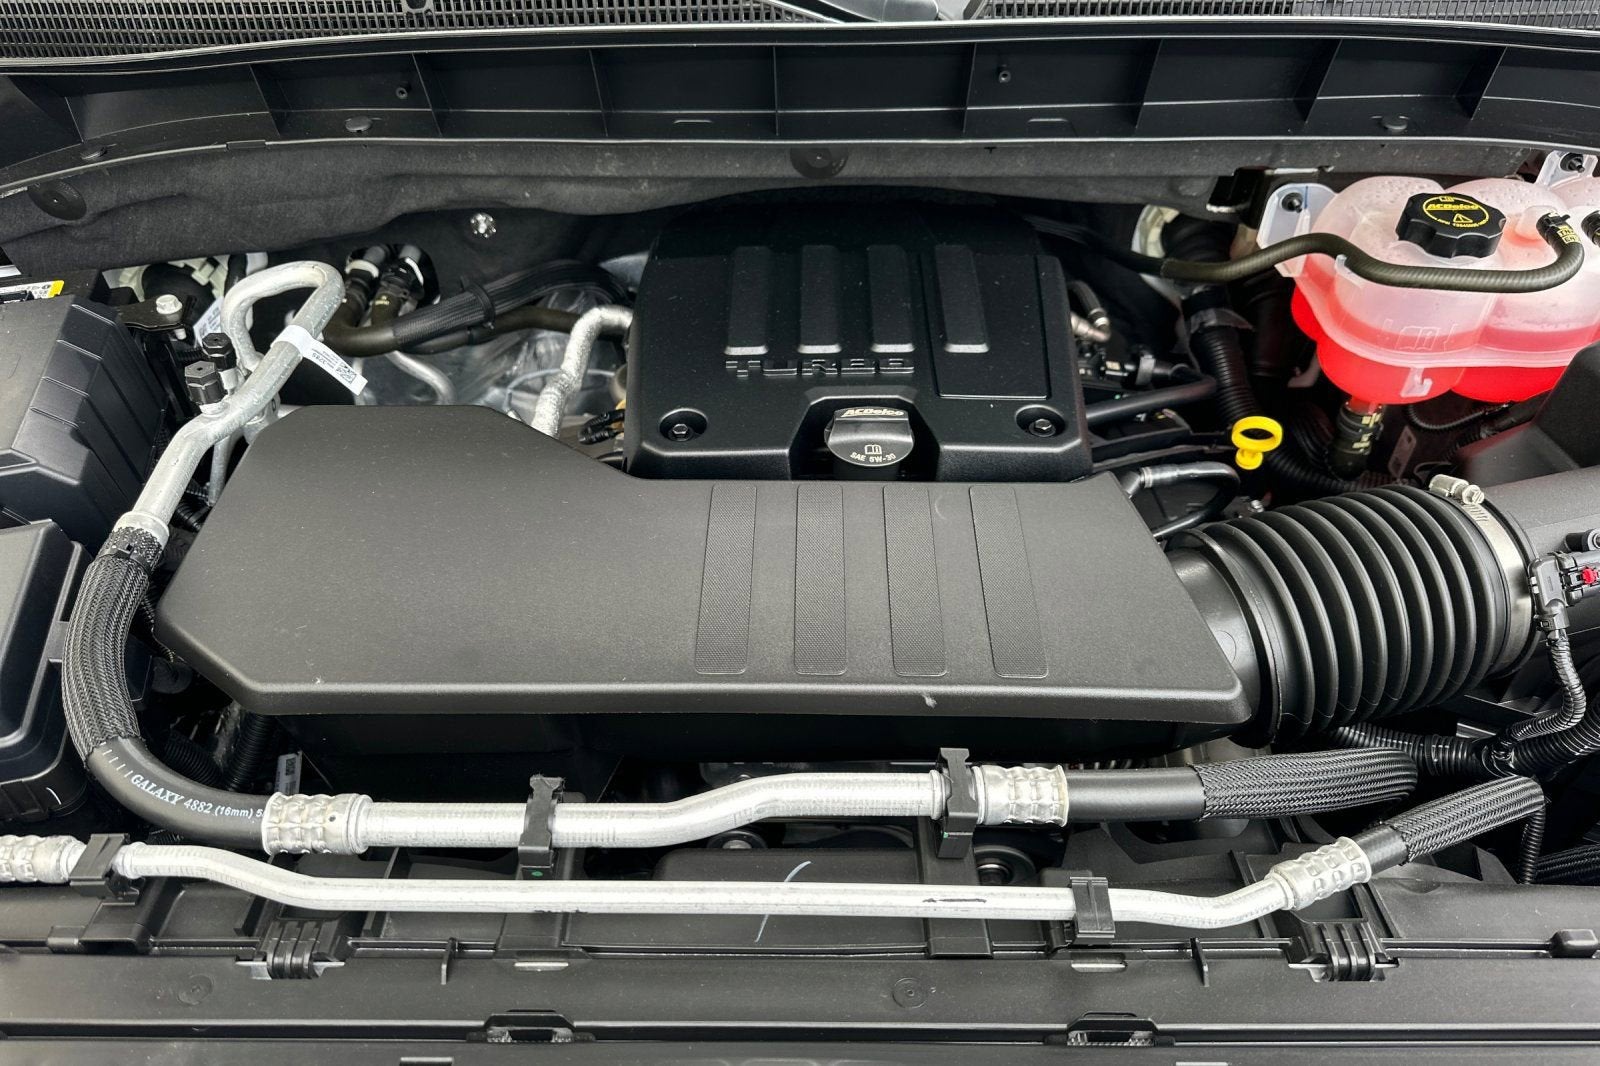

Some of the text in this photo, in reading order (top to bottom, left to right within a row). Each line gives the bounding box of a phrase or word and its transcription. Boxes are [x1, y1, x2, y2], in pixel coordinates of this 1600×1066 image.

[1425, 203, 1480, 211] ACDelco
[725, 358, 915, 378] TURBO
[840, 407, 905, 418] ACDelco
[850, 450, 897, 464] SAE 5W-30
[131, 774, 185, 805] GALAXY
[183, 798, 213, 814] 4882
[214, 805, 254, 820] (16mm)
